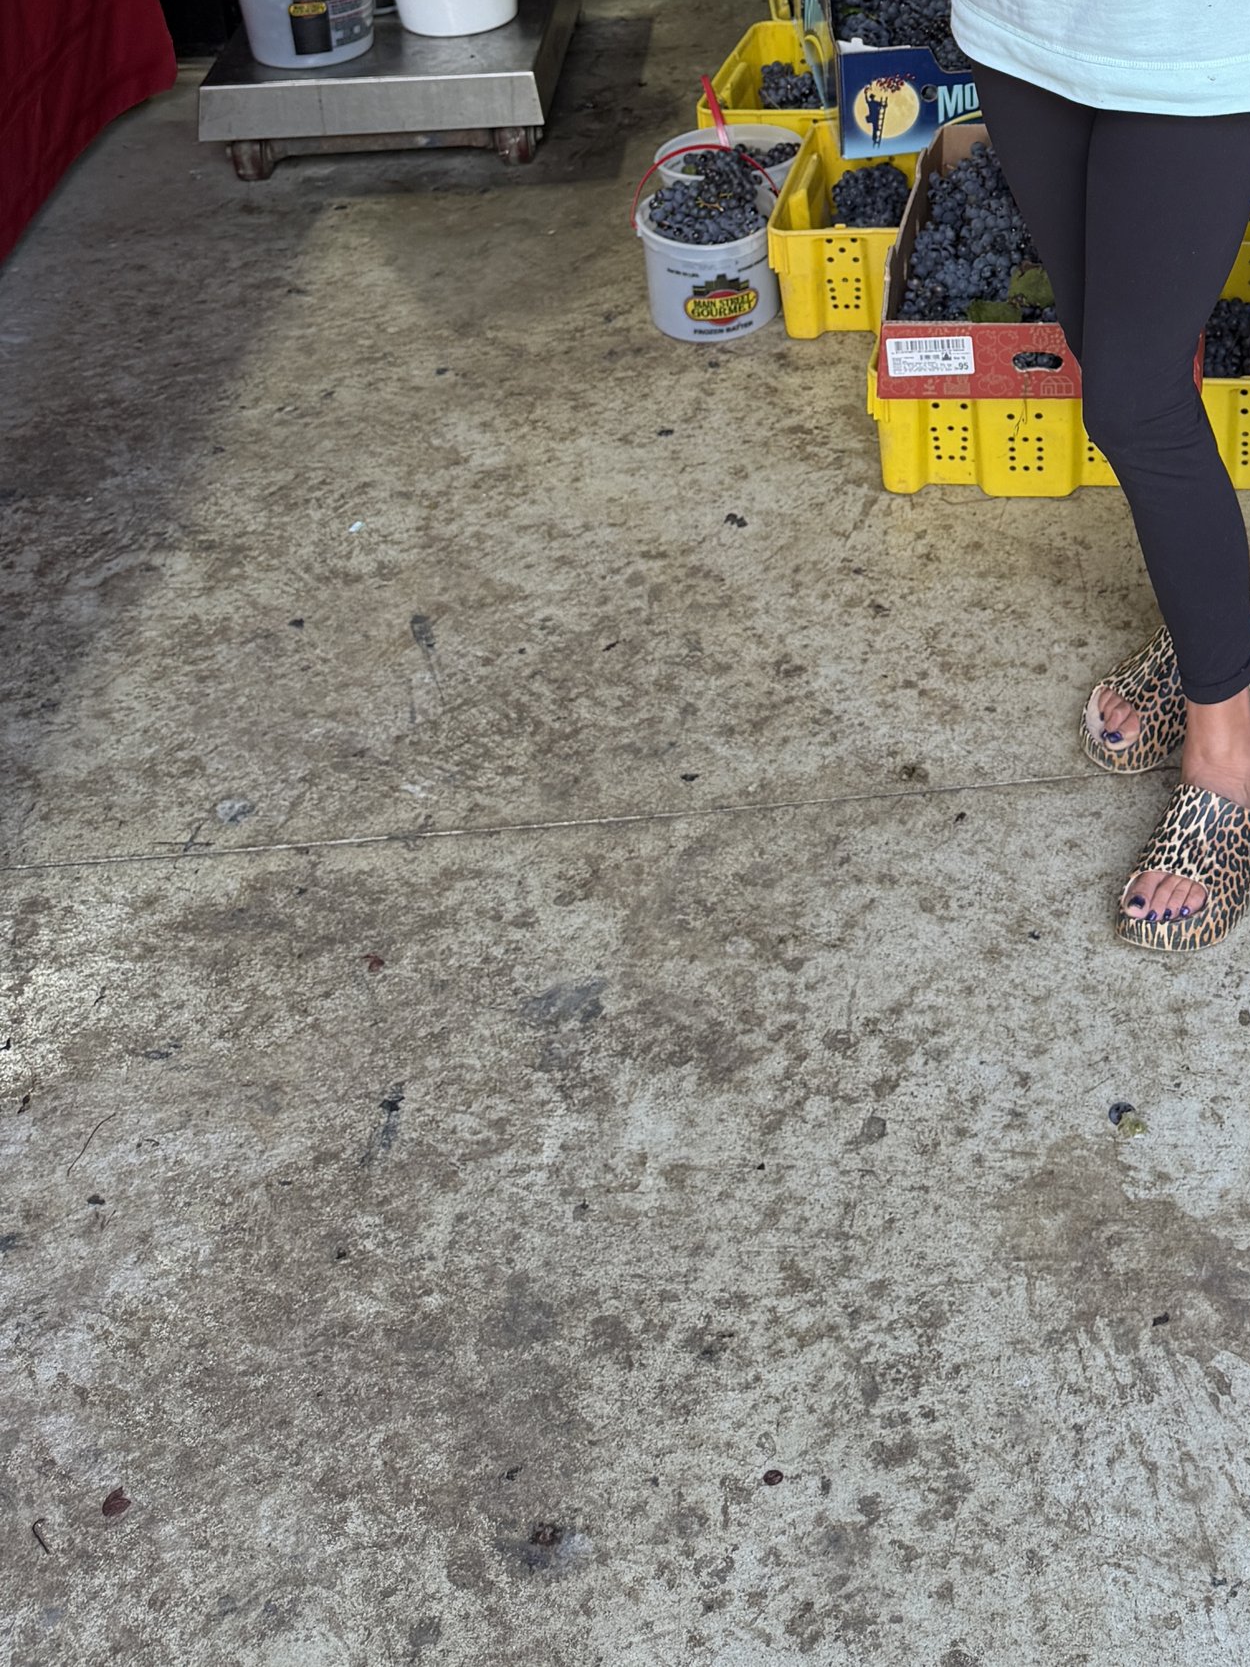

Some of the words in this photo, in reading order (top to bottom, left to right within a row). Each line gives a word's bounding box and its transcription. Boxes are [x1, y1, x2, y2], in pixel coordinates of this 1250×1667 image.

[937, 82, 980, 124] MO
[691, 300, 753, 318] GOURMET
[693, 299, 717, 309] MAIN
[719, 292, 755, 307] STREET
